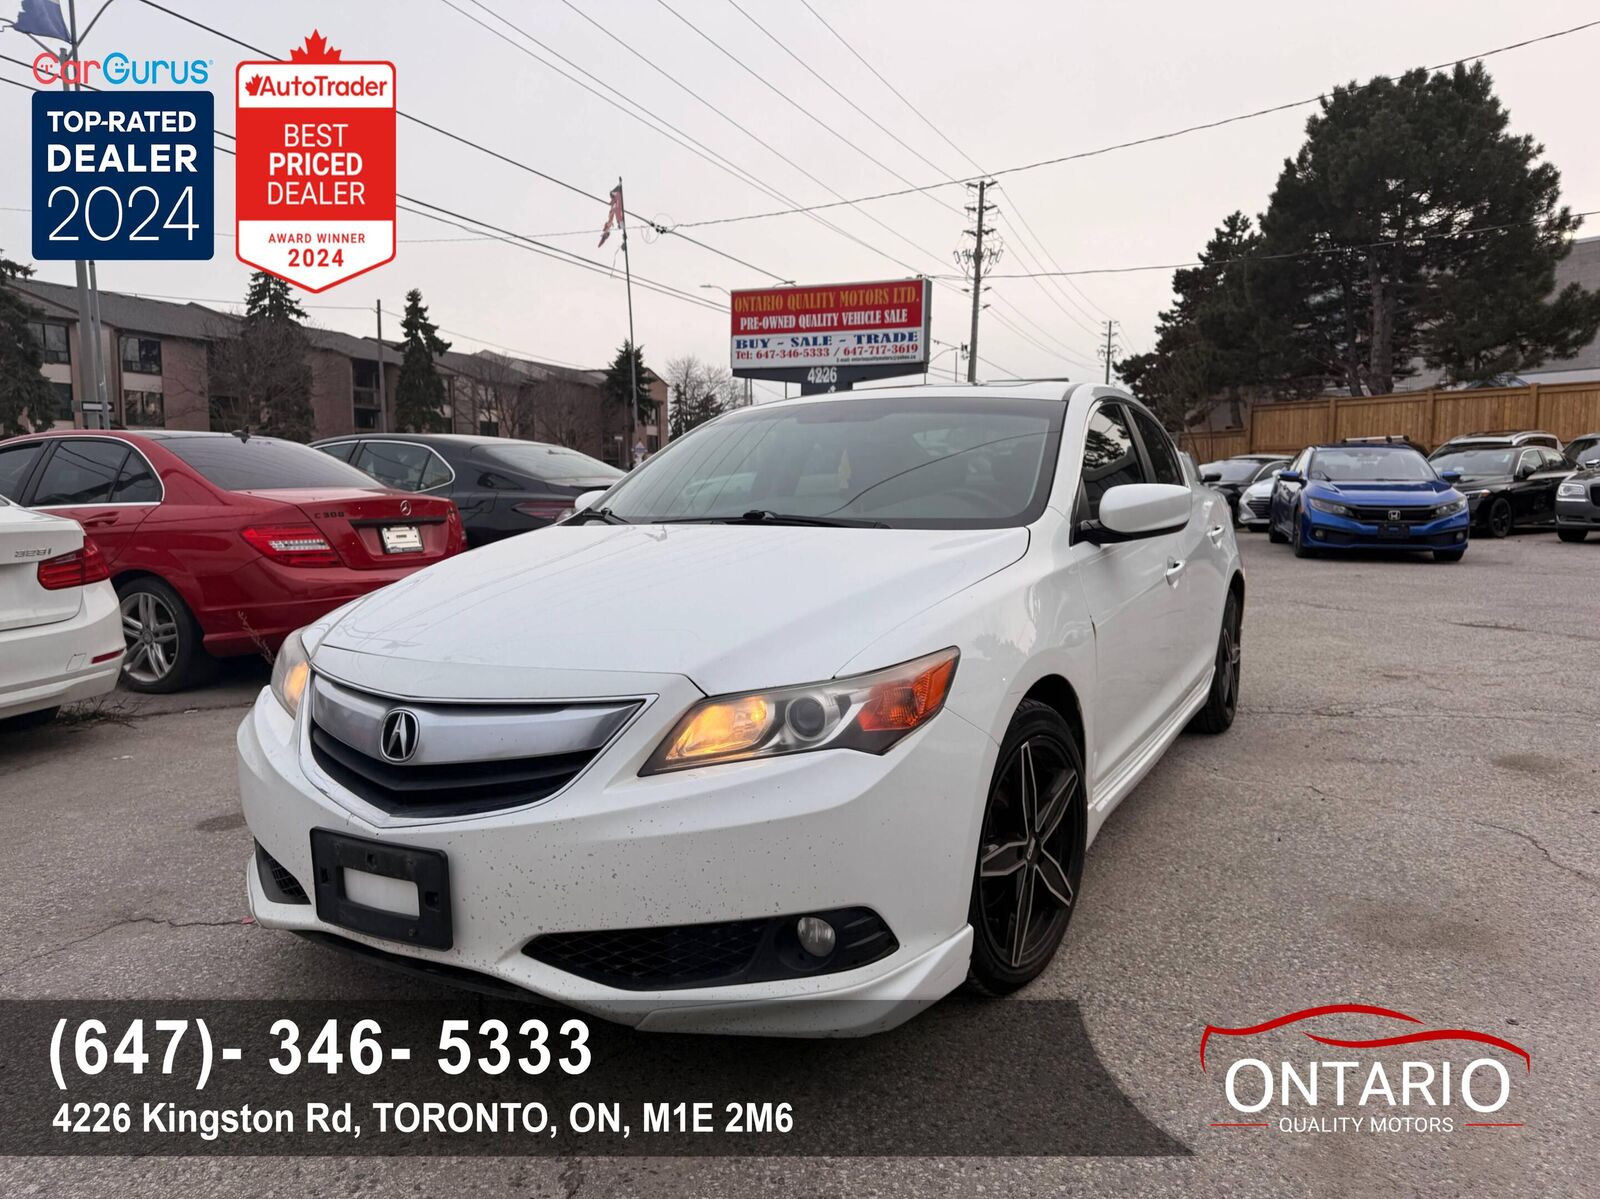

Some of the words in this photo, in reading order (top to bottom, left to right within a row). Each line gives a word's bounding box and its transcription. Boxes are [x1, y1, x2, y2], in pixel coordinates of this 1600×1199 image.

[734, 294, 783, 313] ONTARIO
[787, 291, 836, 311] QUALITY
[840, 287, 889, 307] MOTORS
[893, 286, 920, 304] LTD.
[740, 314, 796, 331] PRE-OWNED
[798, 312, 839, 329] QUALITY
[842, 309, 882, 326] VEHICLE
[884, 308, 908, 324] SALE
[735, 338, 770, 350] BUY
[790, 334, 833, 348] SALE
[853, 331, 918, 345] TRADE
[736, 350, 753, 360] Tel:
[755, 347, 830, 360] 647-346-5333
[843, 343, 918, 357] 647-717-3619
[807, 366, 838, 384] 4226
